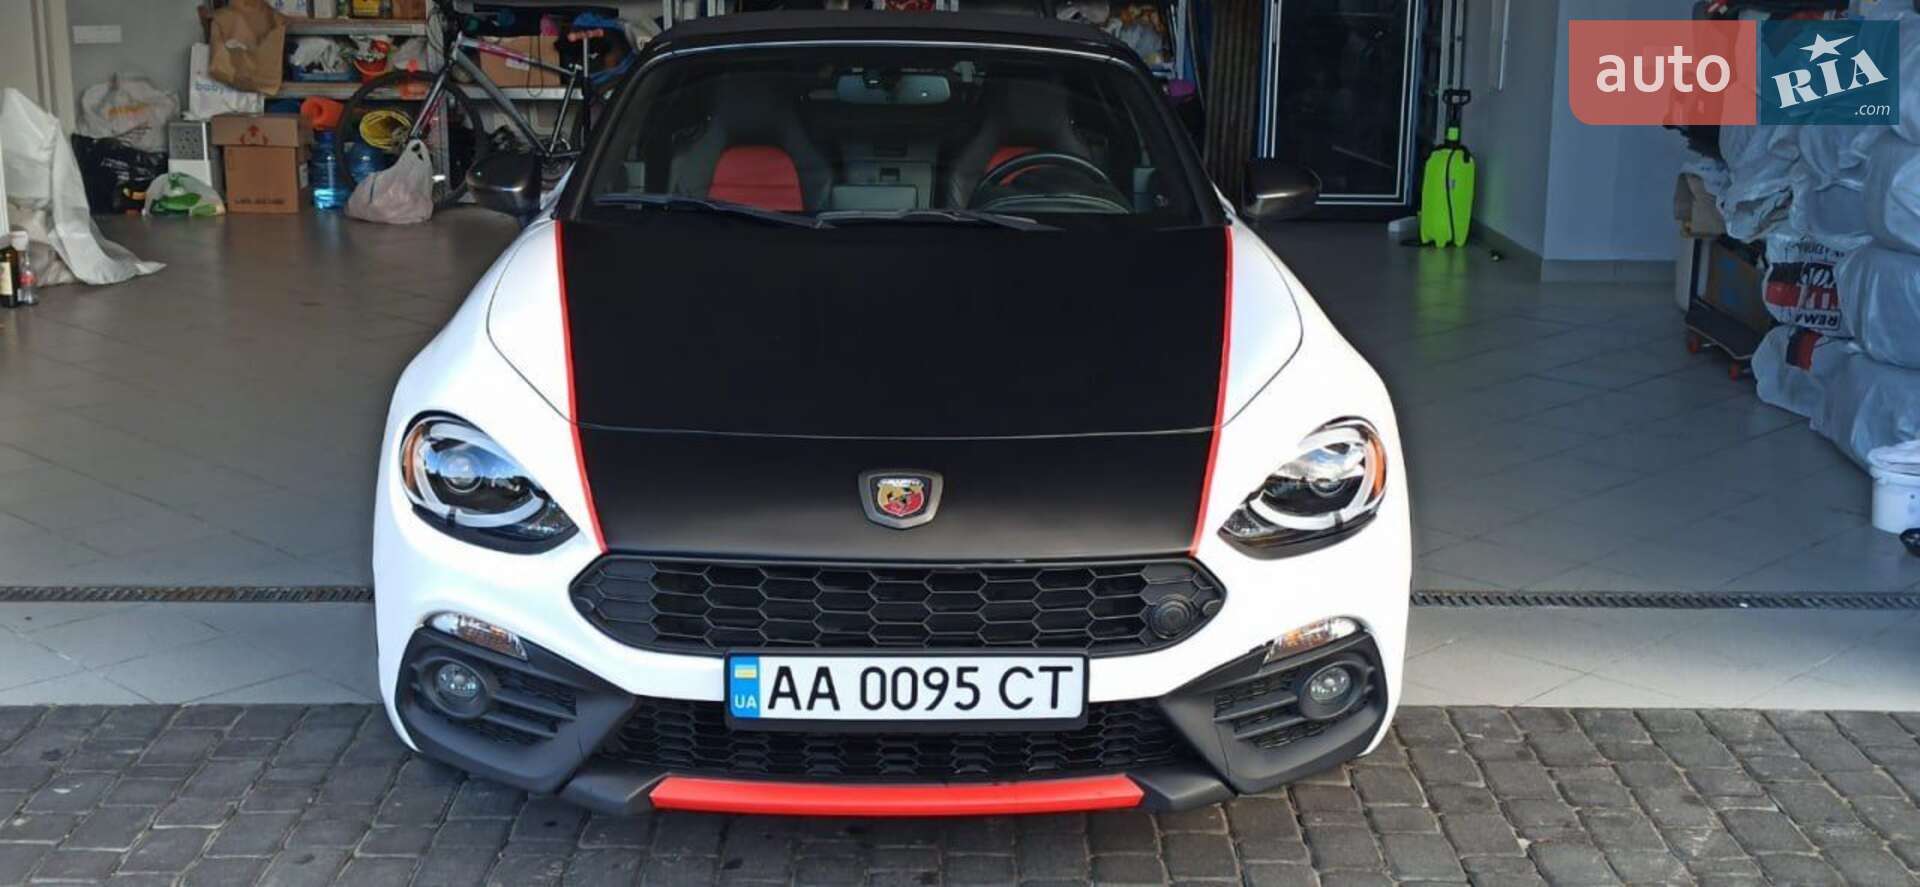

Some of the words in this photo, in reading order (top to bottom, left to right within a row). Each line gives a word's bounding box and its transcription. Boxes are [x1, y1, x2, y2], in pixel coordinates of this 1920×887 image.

[734, 694, 758, 709] UA
[767, 665, 841, 711] AA
[859, 666, 981, 711] 0095
[998, 665, 1074, 711] CT
